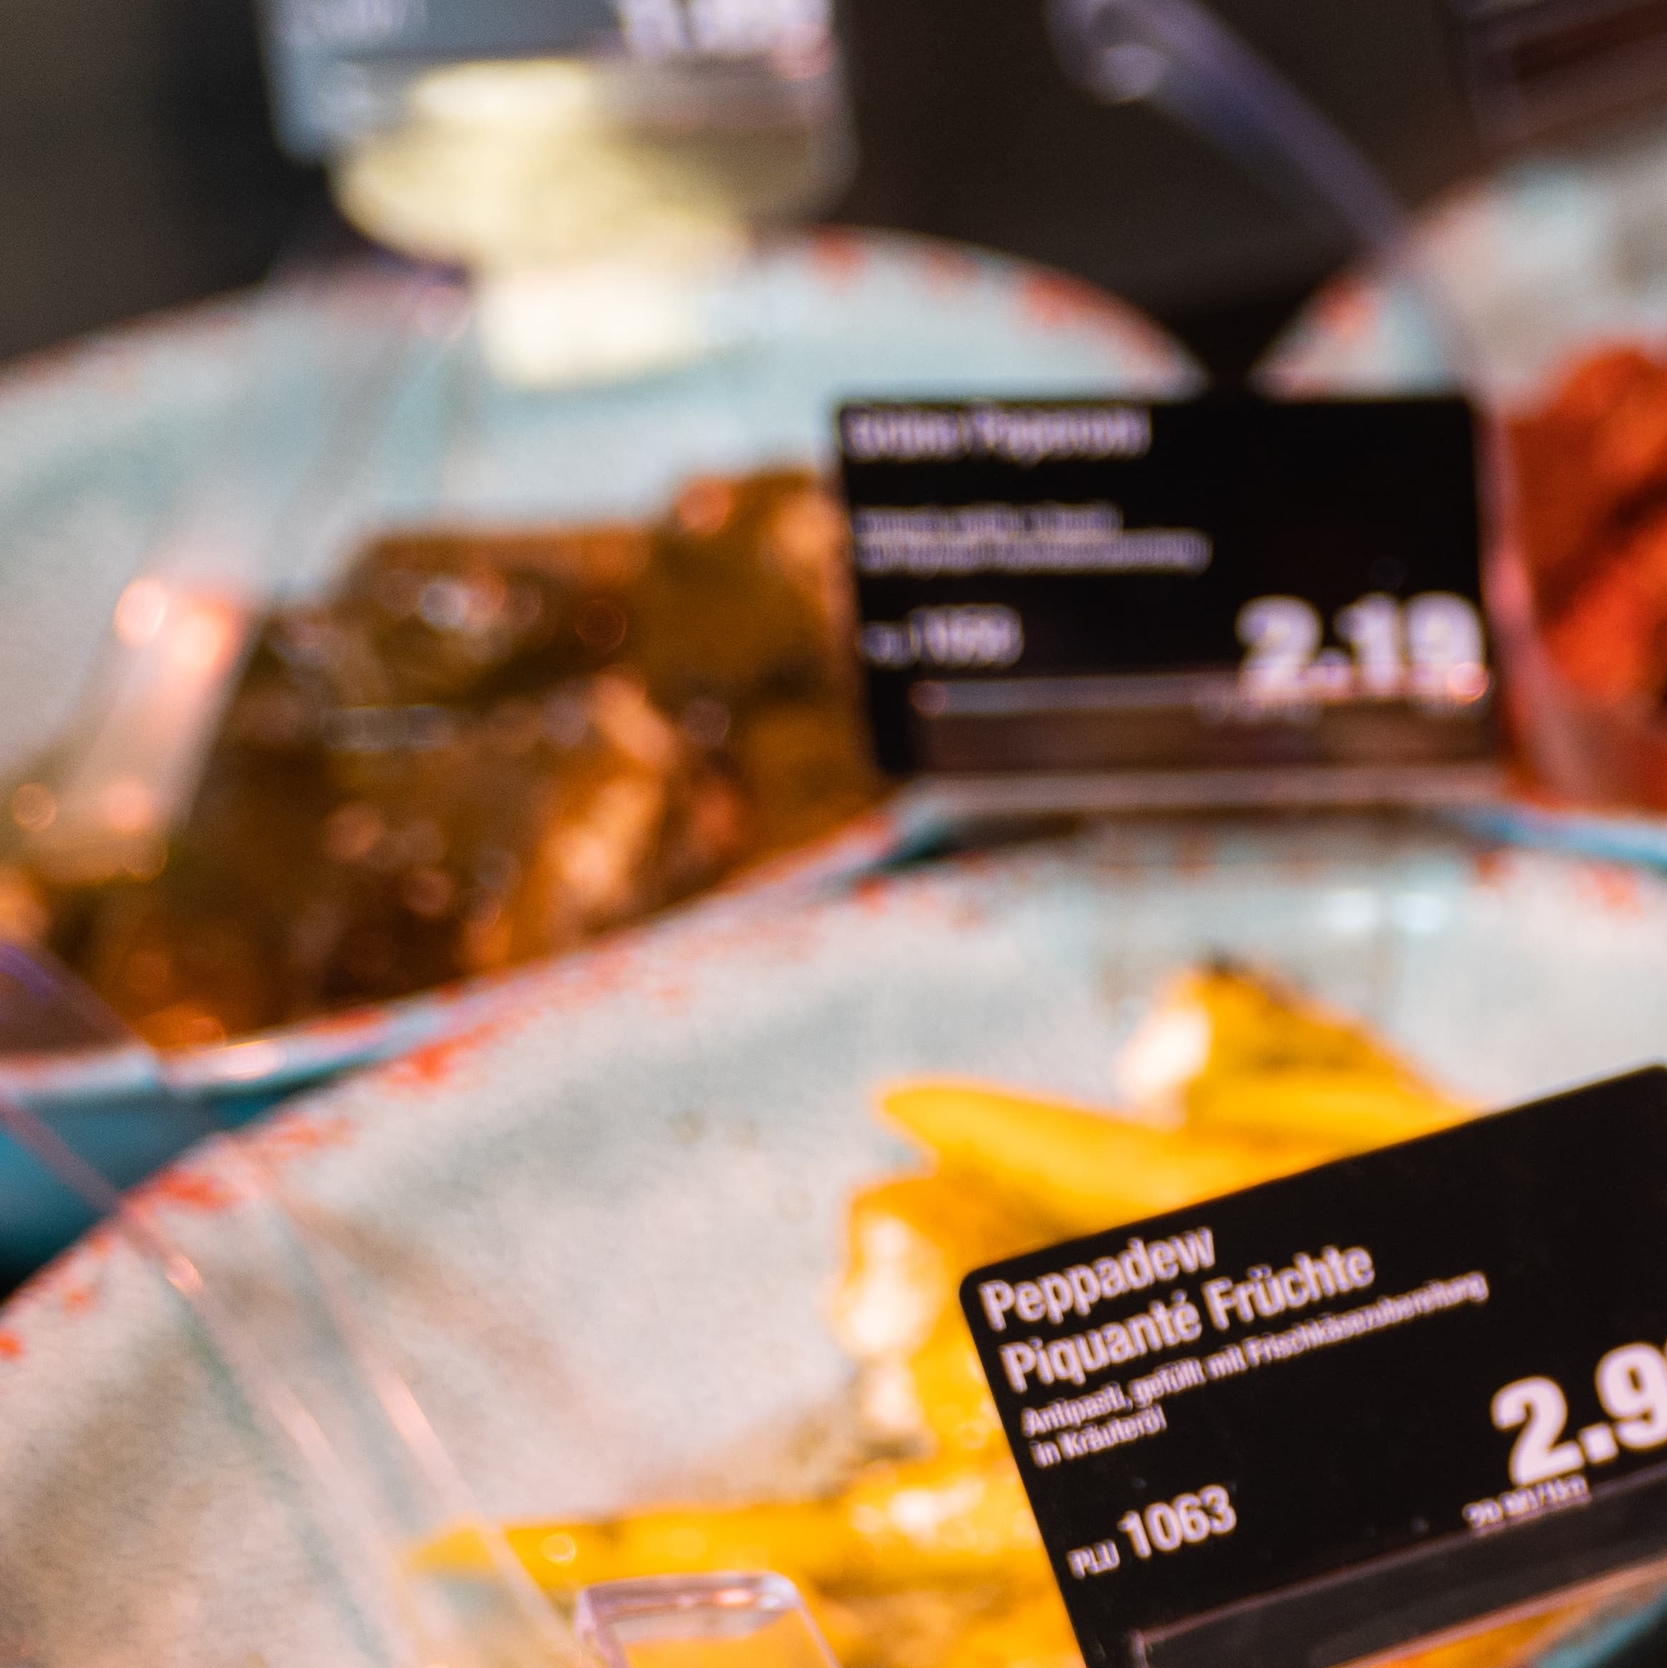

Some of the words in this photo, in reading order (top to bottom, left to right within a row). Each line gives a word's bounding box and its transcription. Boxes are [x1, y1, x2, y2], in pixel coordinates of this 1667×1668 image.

[979, 1227, 1215, 1331] Peppadew
[998, 1289, 1202, 1394] Piquanté
[1200, 1244, 1376, 1331] Früchte
[1203, 1343, 1250, 1380] mit
[1029, 1439, 1063, 1468] in
[1117, 1483, 1238, 1559] 1063
